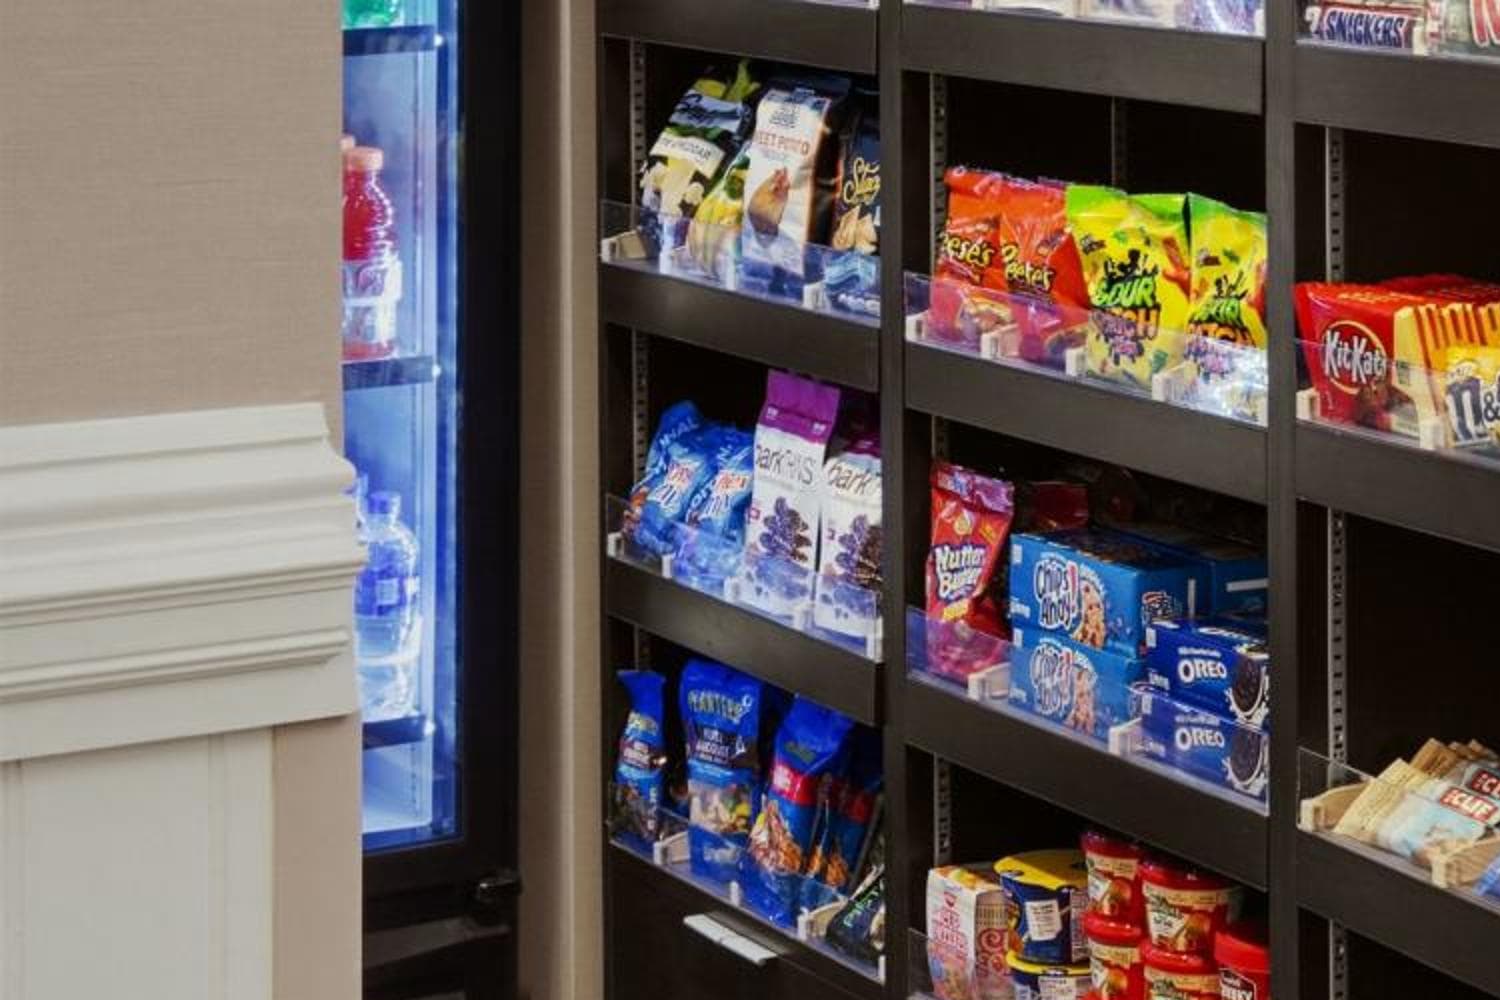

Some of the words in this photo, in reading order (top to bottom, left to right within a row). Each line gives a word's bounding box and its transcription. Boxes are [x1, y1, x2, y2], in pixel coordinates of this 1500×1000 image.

[1326, 10, 1404, 48] SNICKERS
[1177, 659, 1227, 684] OREO
[1175, 727, 1225, 751] OREO
